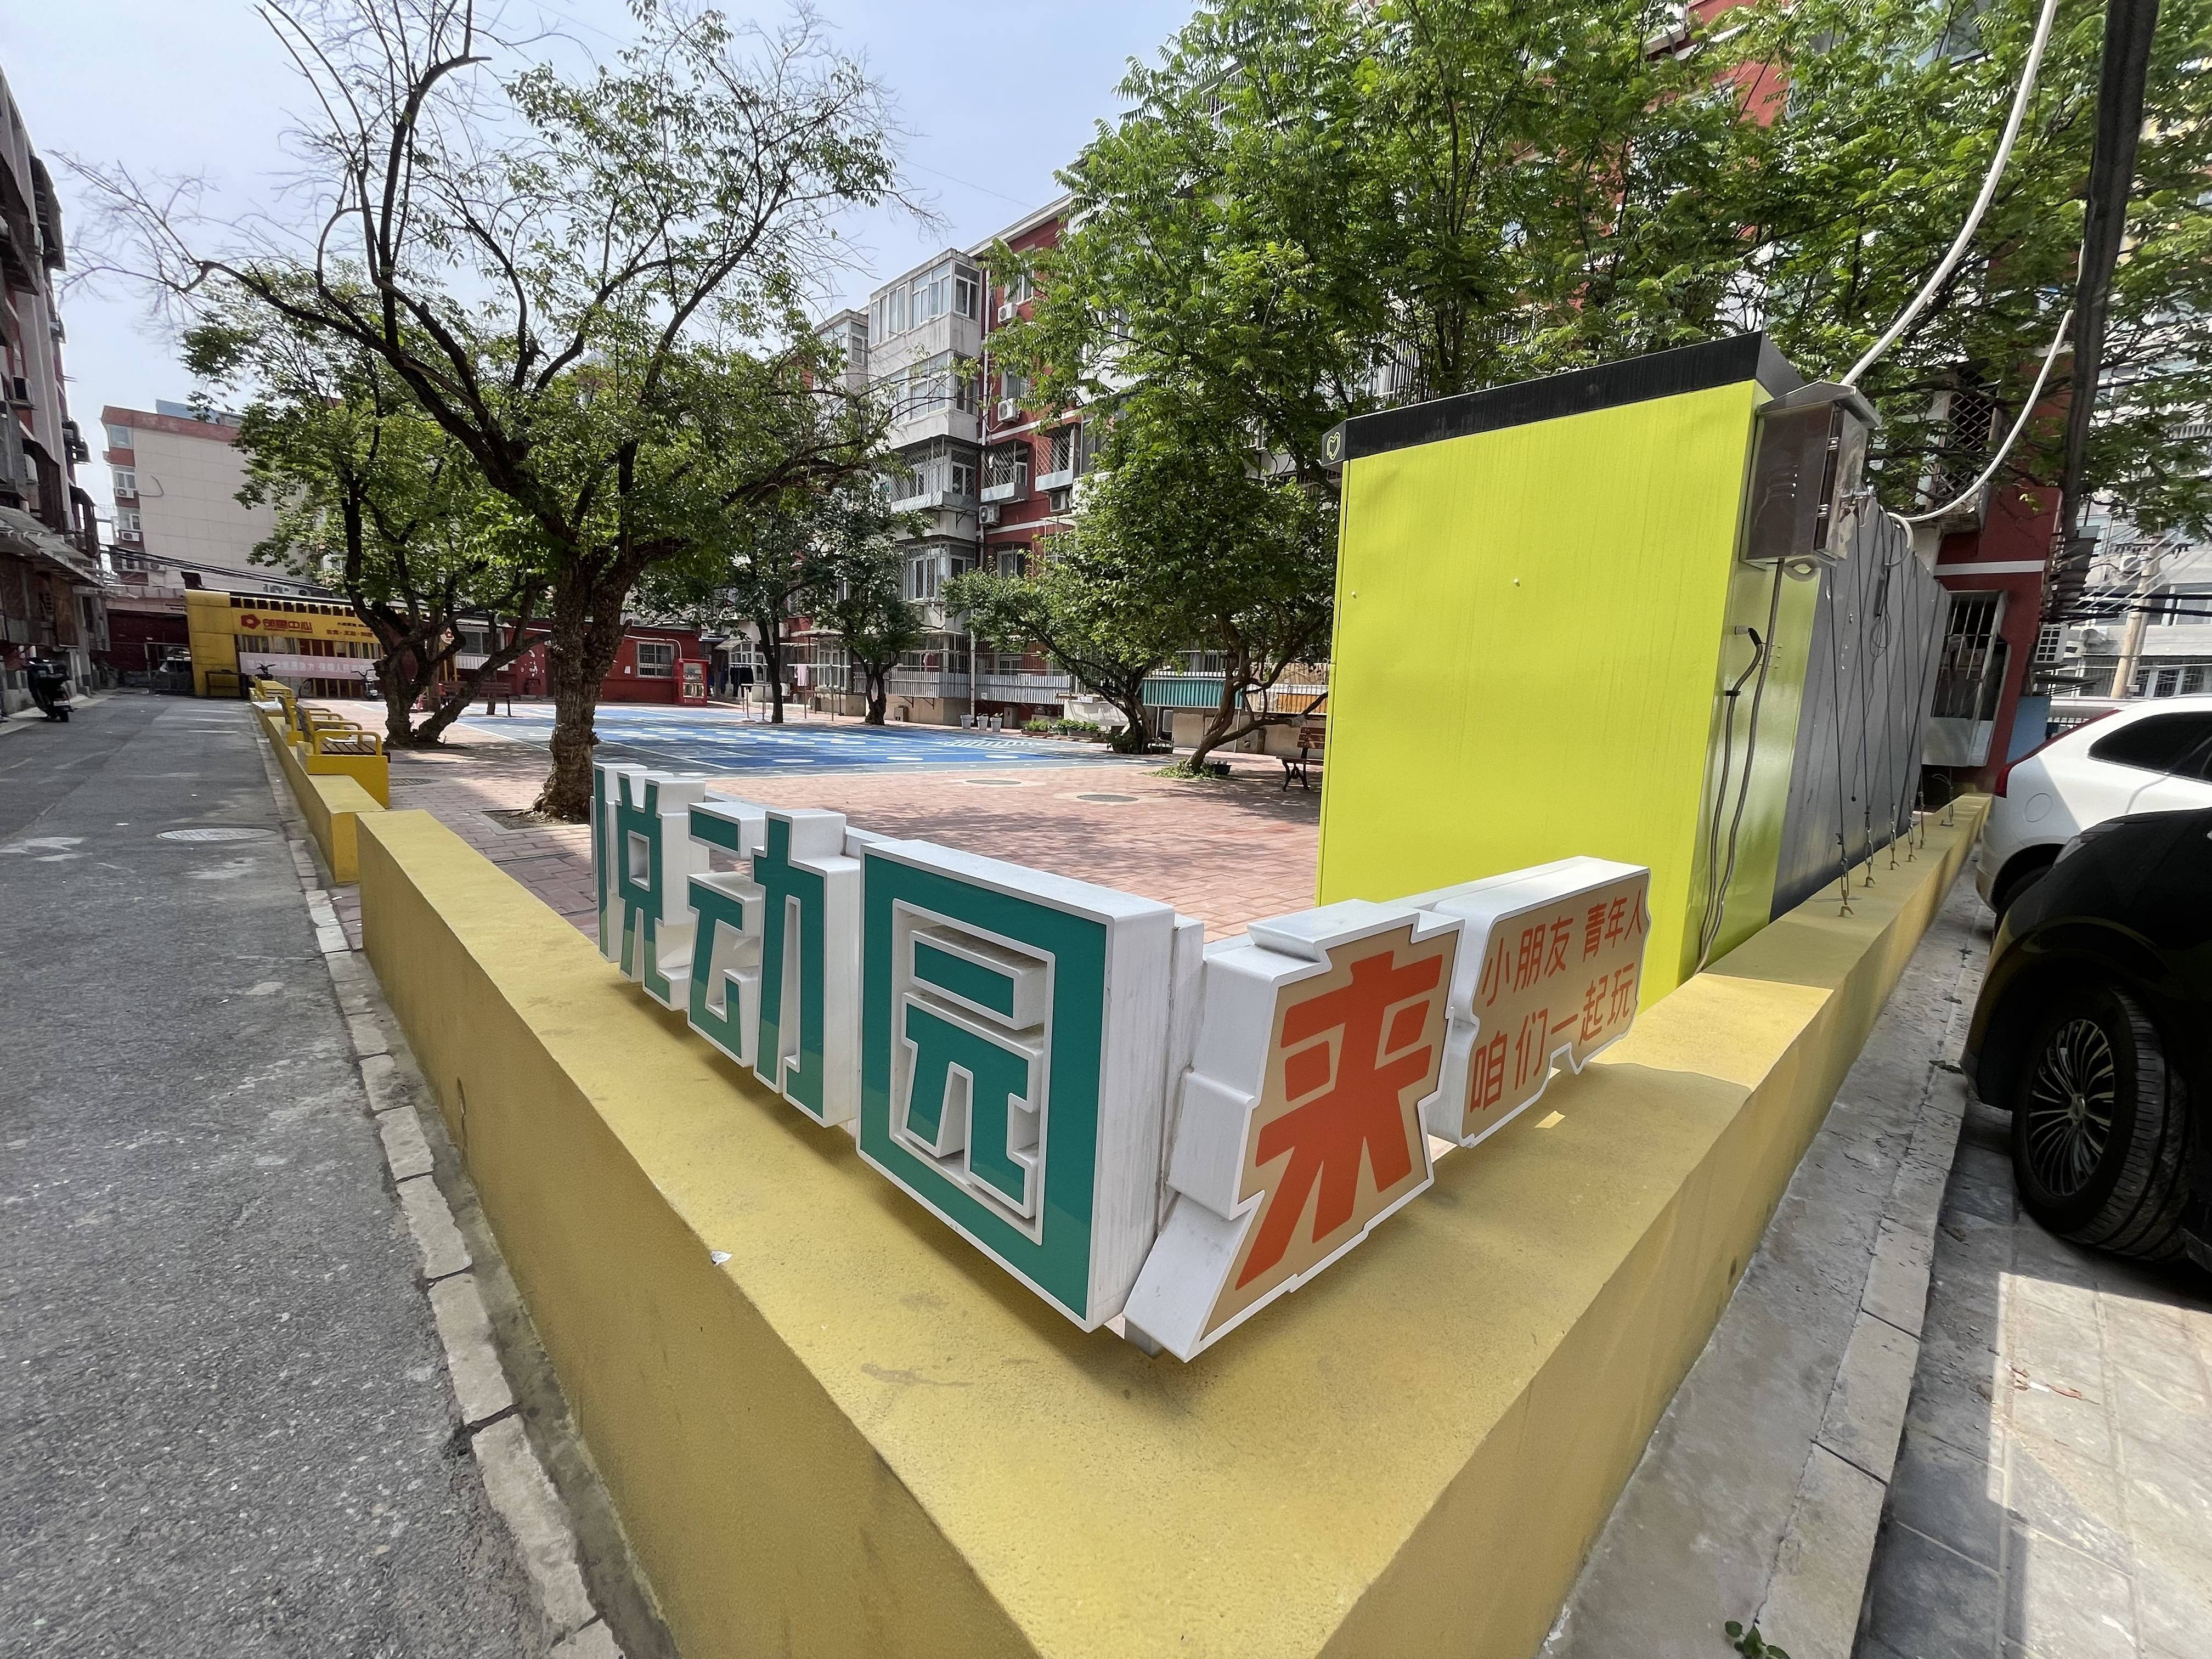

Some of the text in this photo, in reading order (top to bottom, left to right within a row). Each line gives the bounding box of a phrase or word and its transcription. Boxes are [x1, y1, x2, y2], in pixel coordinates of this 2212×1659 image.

[591, 763, 1116, 1332] 悦动园
[1470, 962, 1634, 1113] 咱们一起玩
[1482, 889, 1641, 1007] 小朋友 青年人
[1235, 950, 1443, 1290] 来
